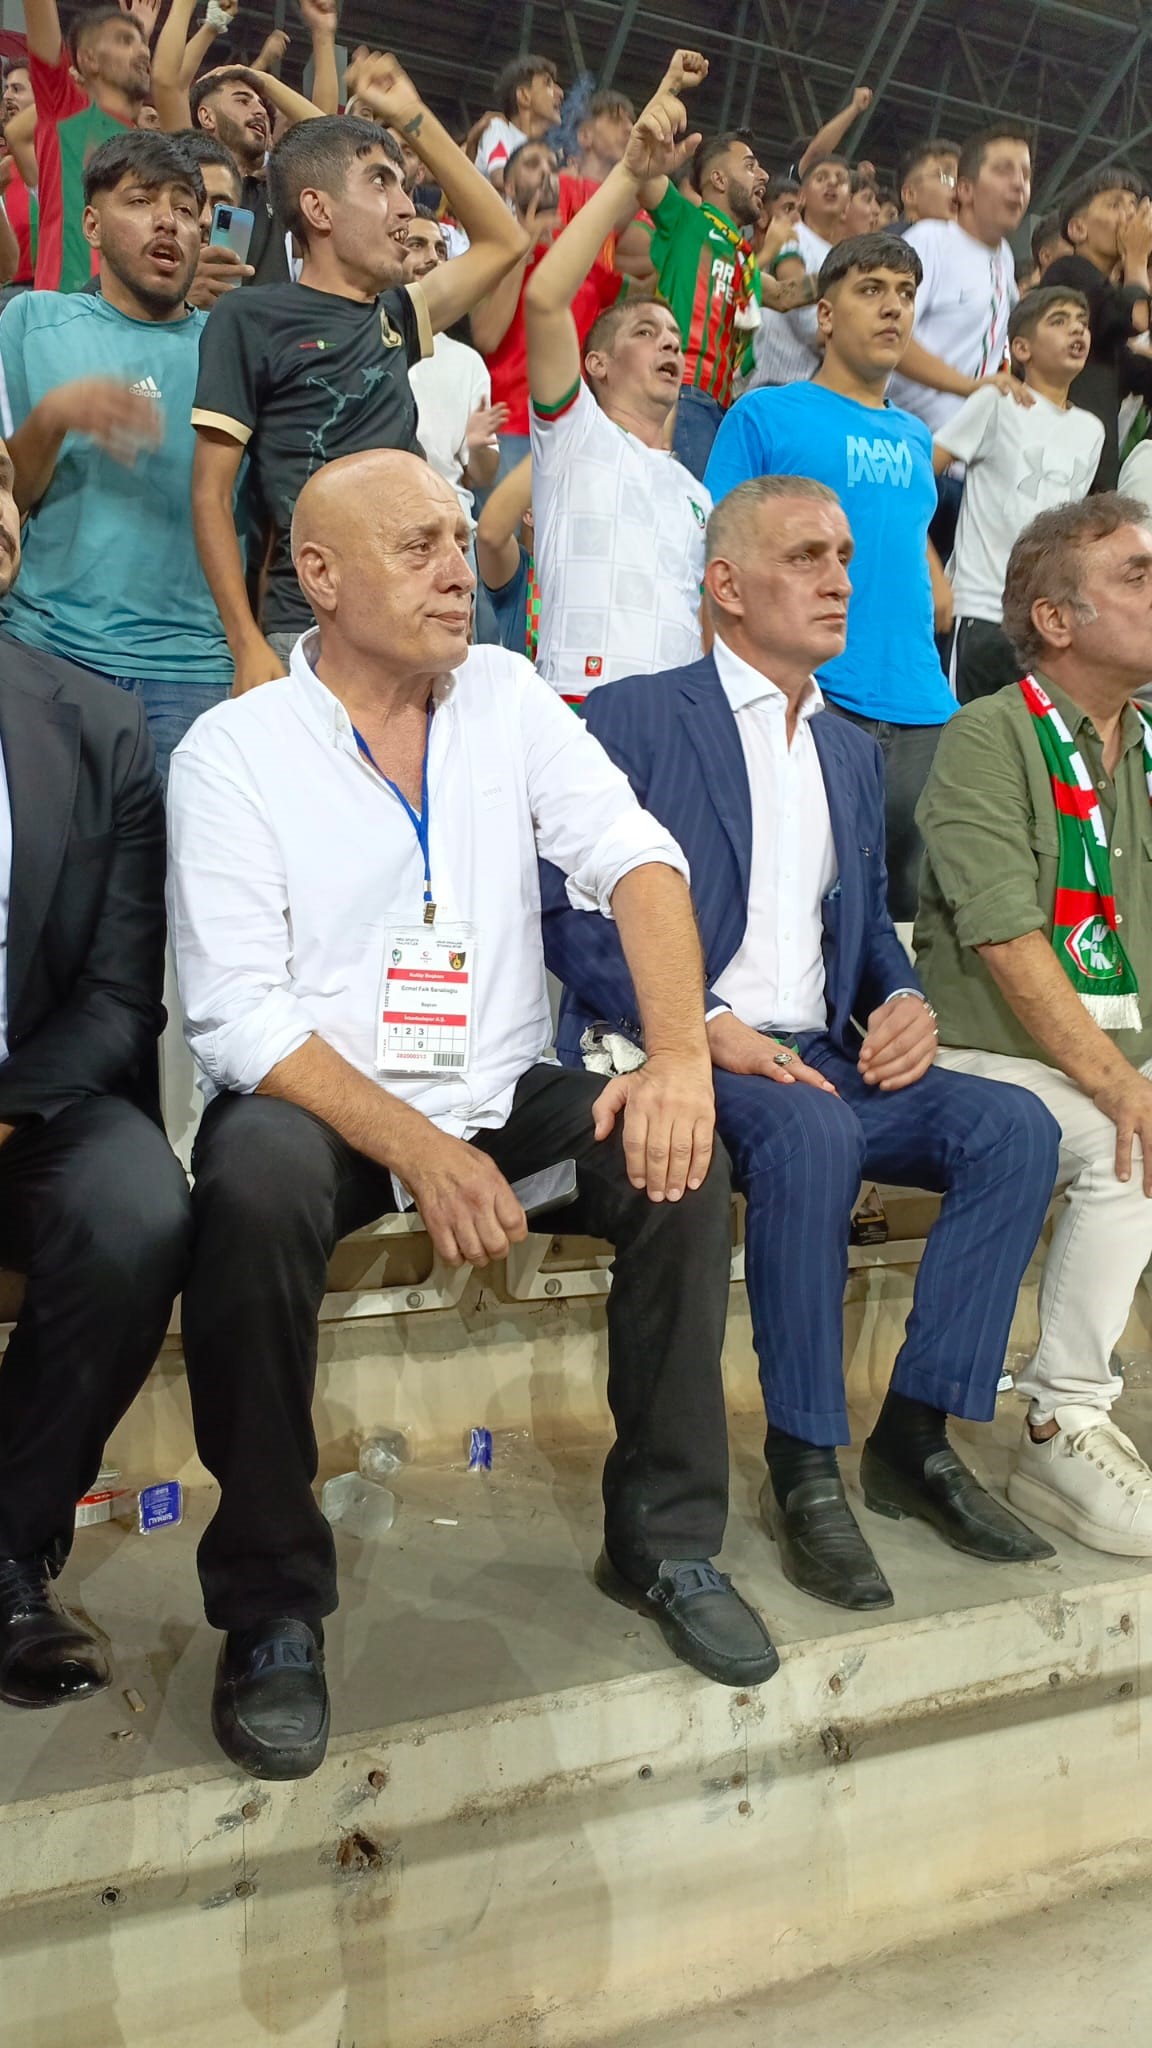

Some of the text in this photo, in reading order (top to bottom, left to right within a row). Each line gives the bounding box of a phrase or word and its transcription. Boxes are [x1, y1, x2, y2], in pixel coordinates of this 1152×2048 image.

[405, 1027, 412, 1035] 2
[418, 1028, 425, 1036] 3
[417, 1041, 424, 1049] 9
